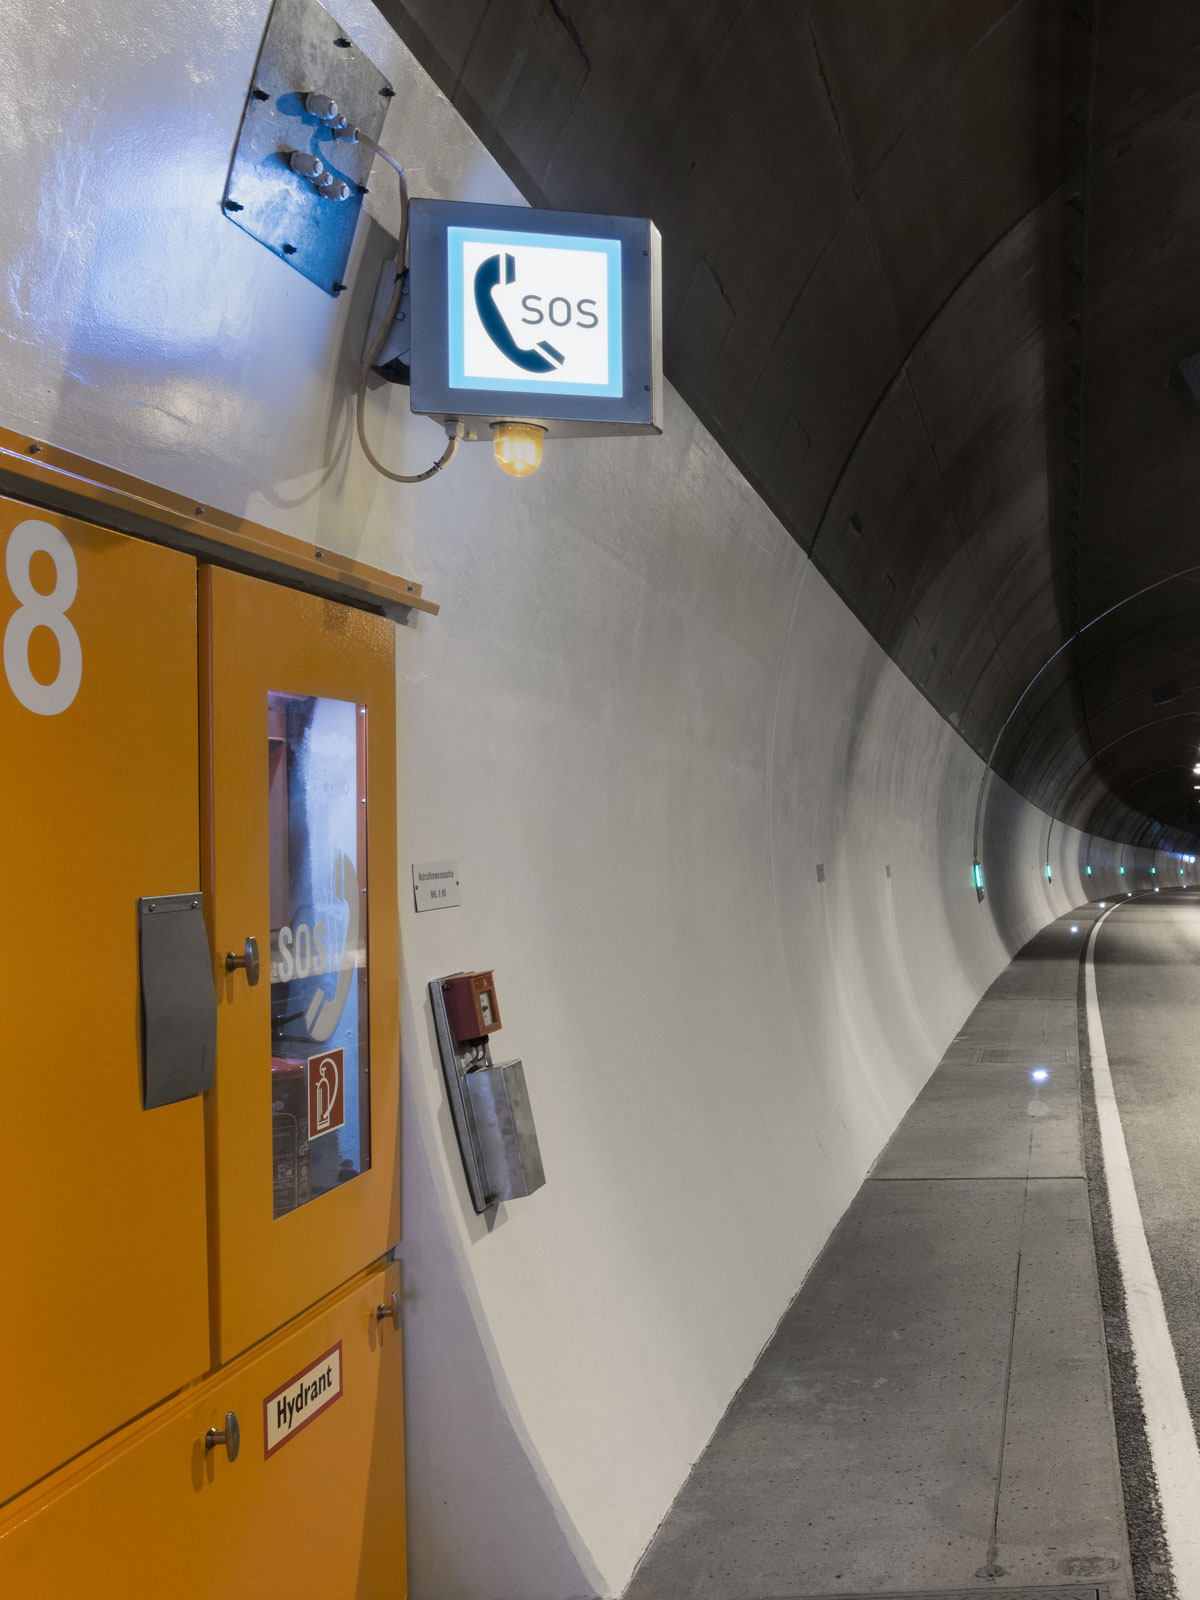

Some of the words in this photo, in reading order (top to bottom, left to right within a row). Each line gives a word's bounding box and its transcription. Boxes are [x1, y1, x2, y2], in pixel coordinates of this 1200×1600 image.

[521, 294, 599, 329] SOS
[3, 519, 83, 716] 8
[278, 922, 327, 983] SOS
[276, 1364, 333, 1430] Hydrant
